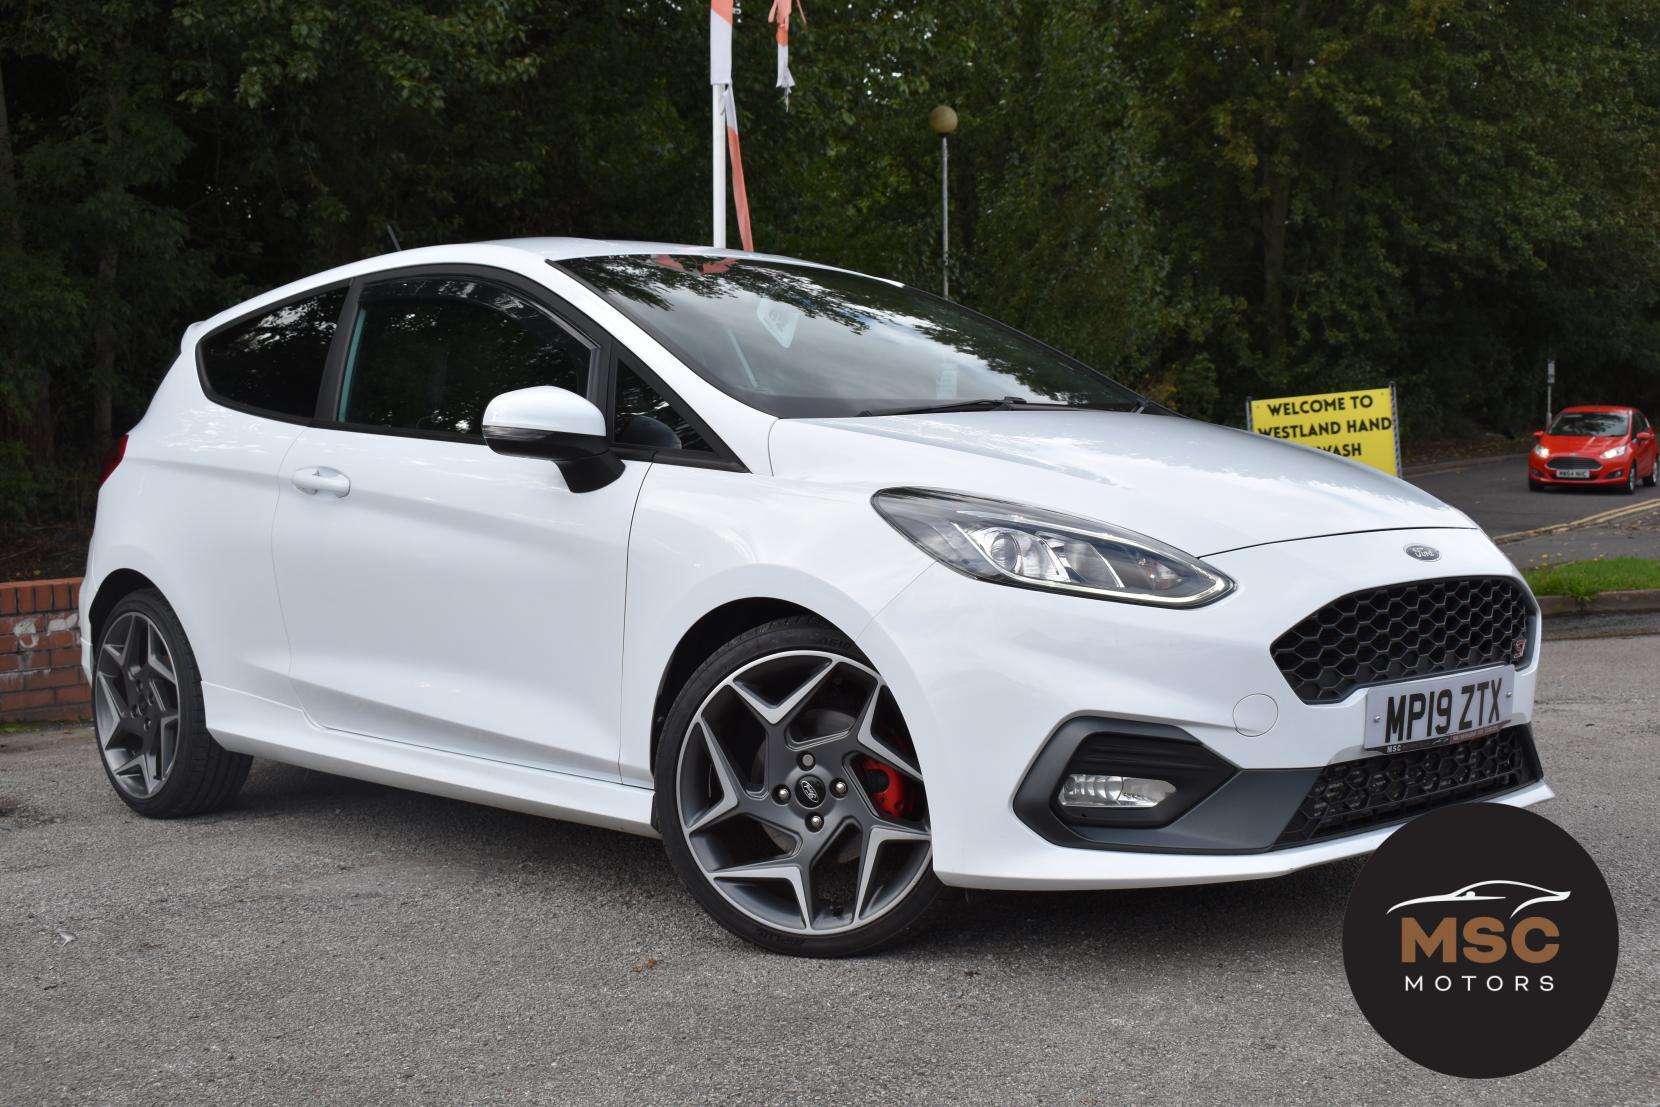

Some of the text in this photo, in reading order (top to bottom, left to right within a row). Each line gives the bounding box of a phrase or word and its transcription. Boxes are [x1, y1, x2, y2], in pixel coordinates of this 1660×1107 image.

[1267, 395, 1373, 416] WELCOME TO
[1347, 417, 1392, 433] HAND
[1384, 688, 1453, 743] MP19
[1458, 678, 1502, 731] ZTX
[1387, 744, 1402, 753] MSC
